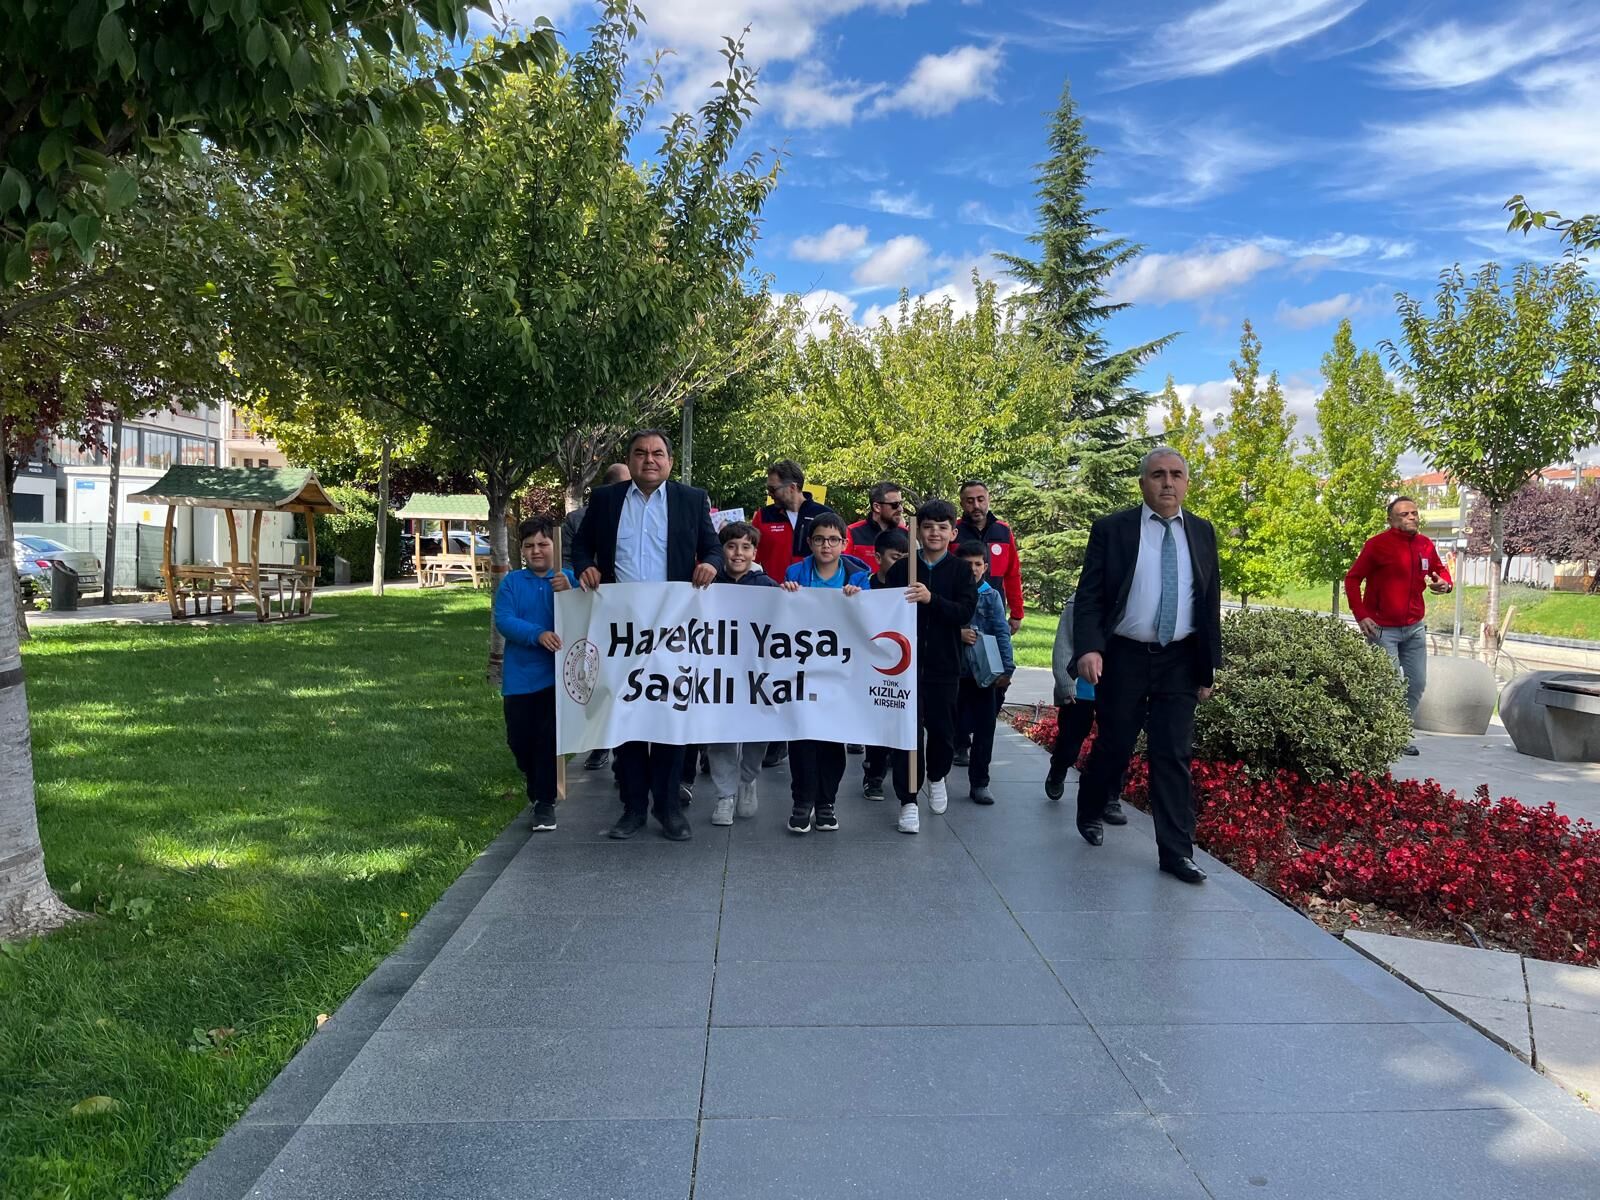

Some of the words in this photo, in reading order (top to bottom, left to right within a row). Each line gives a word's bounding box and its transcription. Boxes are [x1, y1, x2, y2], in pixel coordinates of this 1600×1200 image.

[750, 622, 851, 664] Yaşa,
[748, 670, 817, 705] Kal.
[883, 679, 899, 687] TÜRK
[869, 686, 911, 700] KIZILAY
[874, 698, 906, 709] KIRŞEHİR
